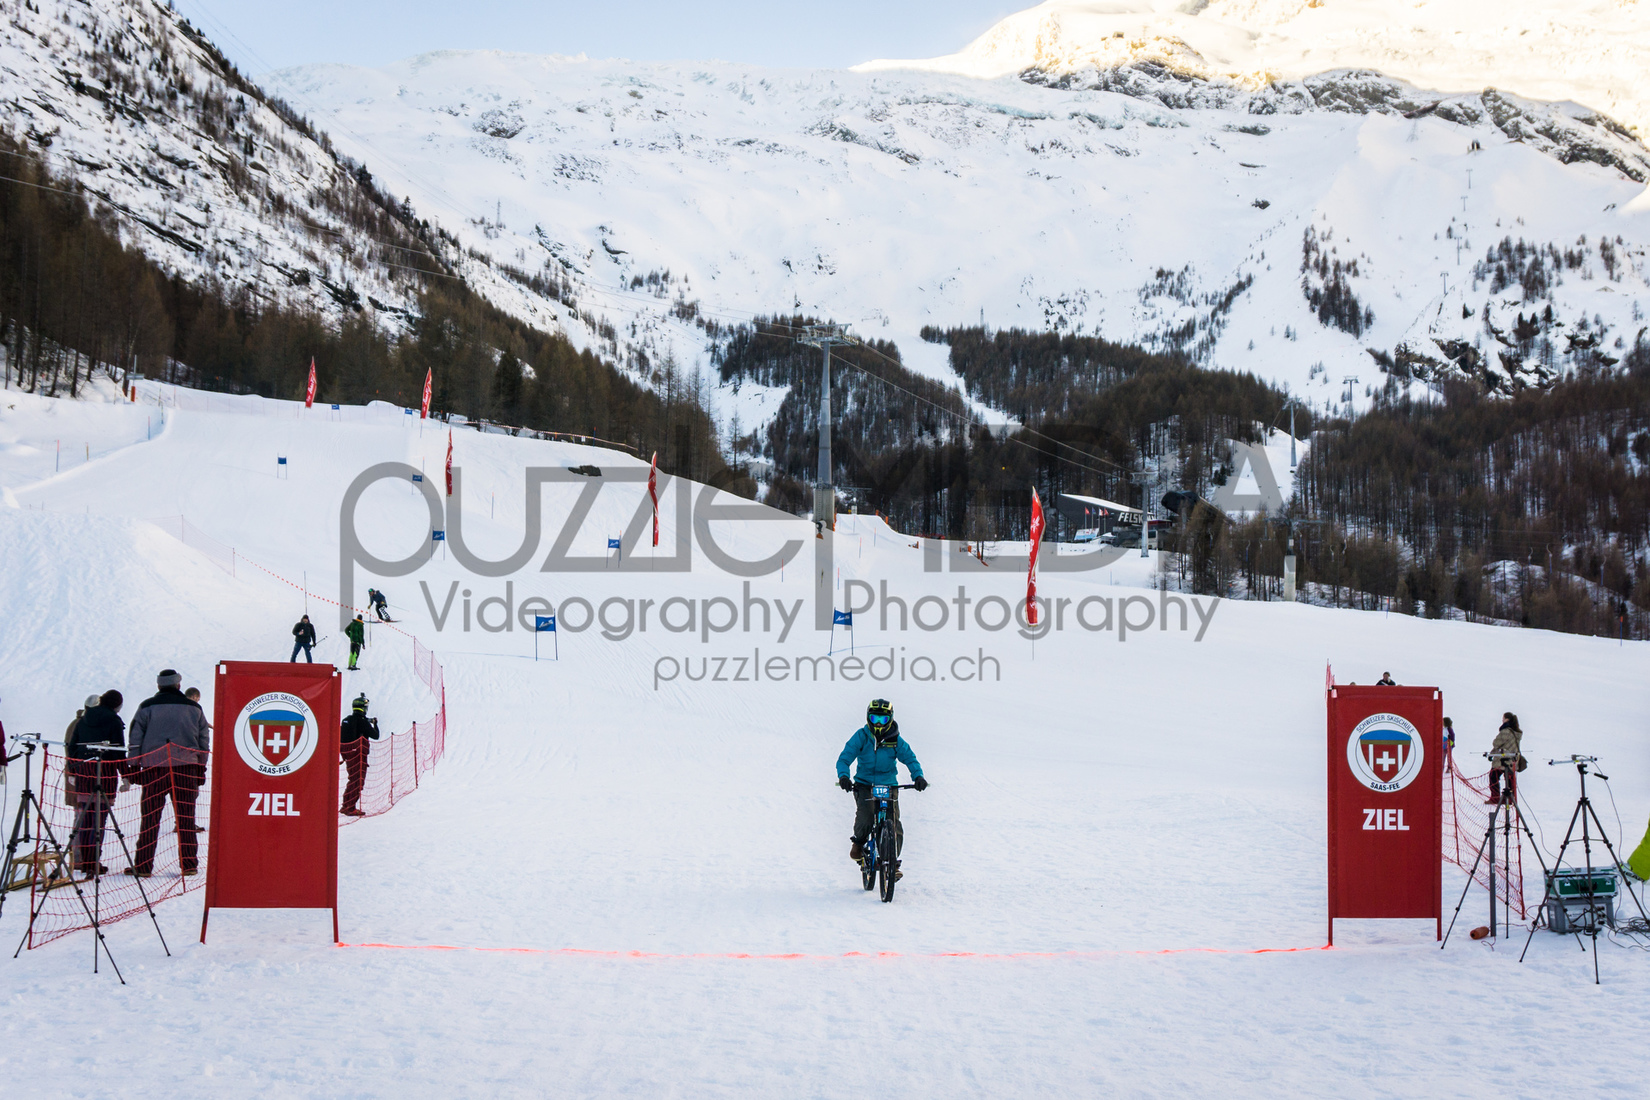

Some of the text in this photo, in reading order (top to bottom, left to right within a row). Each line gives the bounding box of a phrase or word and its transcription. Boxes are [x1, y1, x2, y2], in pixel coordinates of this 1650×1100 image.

[245, 694, 309, 713] SCHWEIZER SKISCHULE
[1356, 715, 1414, 733] SCHWEIZER SKISCHULE
[258, 764, 291, 774] SAAS-FEE
[1370, 782, 1401, 791] SAAS-FEE
[247, 792, 300, 816] ZIEL
[1362, 808, 1410, 831] ZIEL
